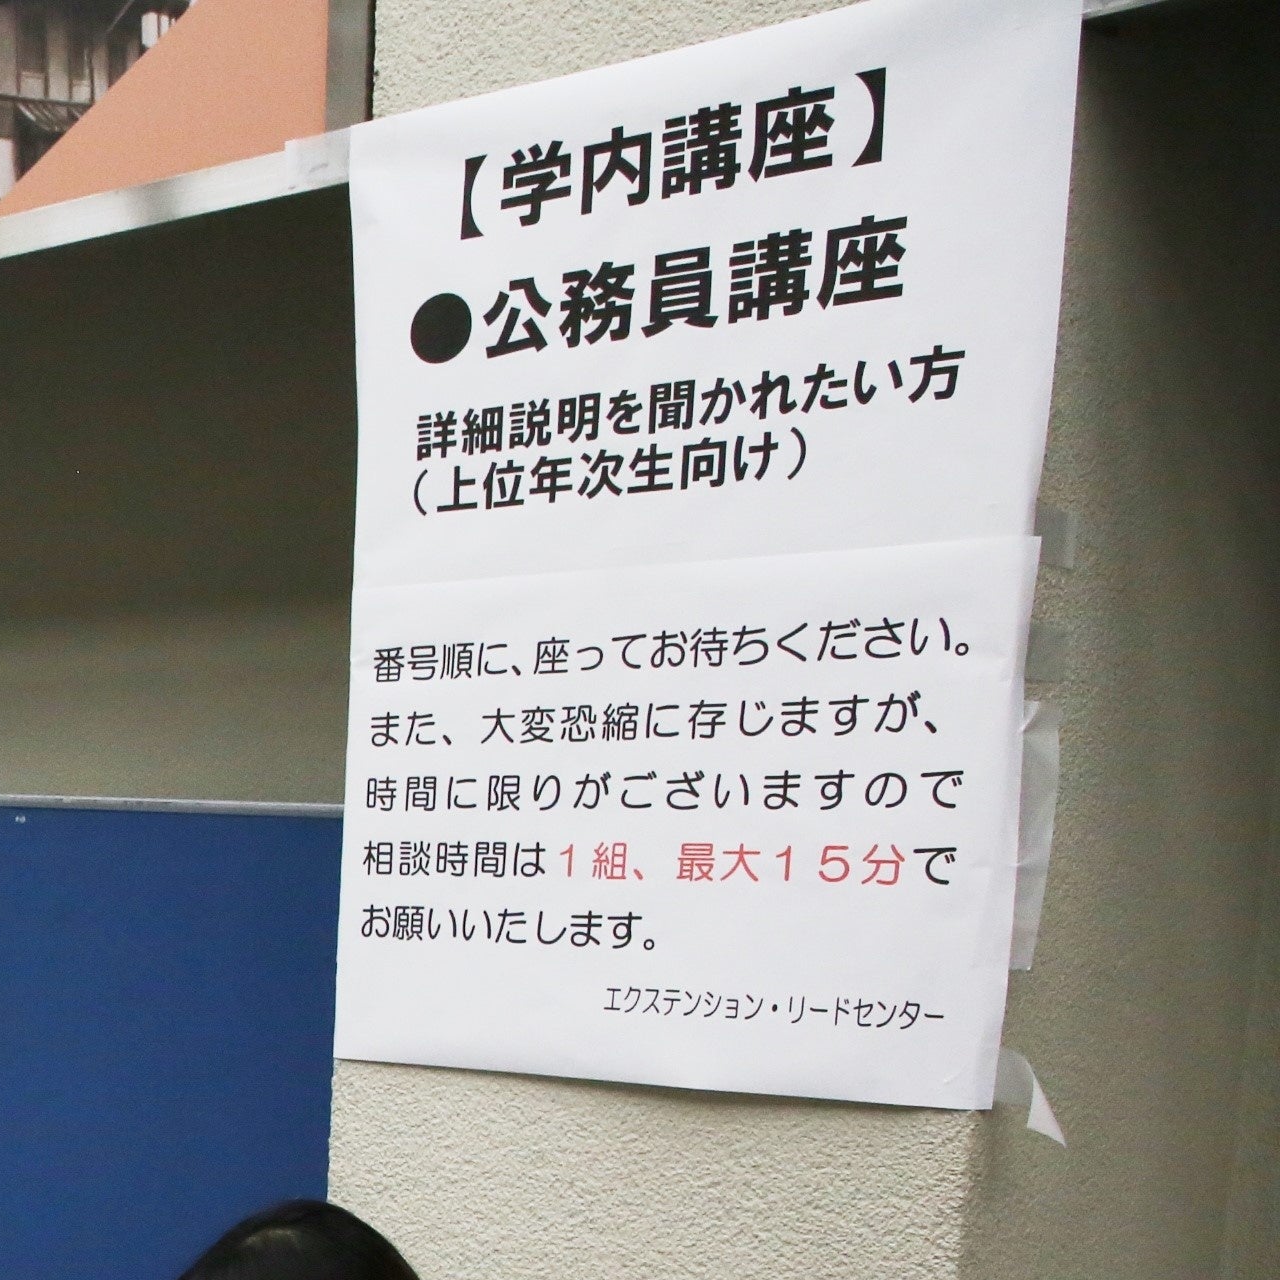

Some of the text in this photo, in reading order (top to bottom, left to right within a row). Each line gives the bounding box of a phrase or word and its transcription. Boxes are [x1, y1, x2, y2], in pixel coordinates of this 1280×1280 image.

[459, 67, 887, 240] 【学内講座】
[415, 344, 966, 462] 詳細説明を聞かれたい方
[412, 428, 807, 517] （上位年次生向け）
[372, 617, 971, 683] 番号順に、座ってお待ちください。
[368, 693, 940, 748] また、大変恐縮に存じますが、
[365, 769, 965, 813] 時間に限りがございますので
[359, 906, 658, 952] お願いいたします。
[602, 986, 945, 1030] エクステンション・リードセンター
